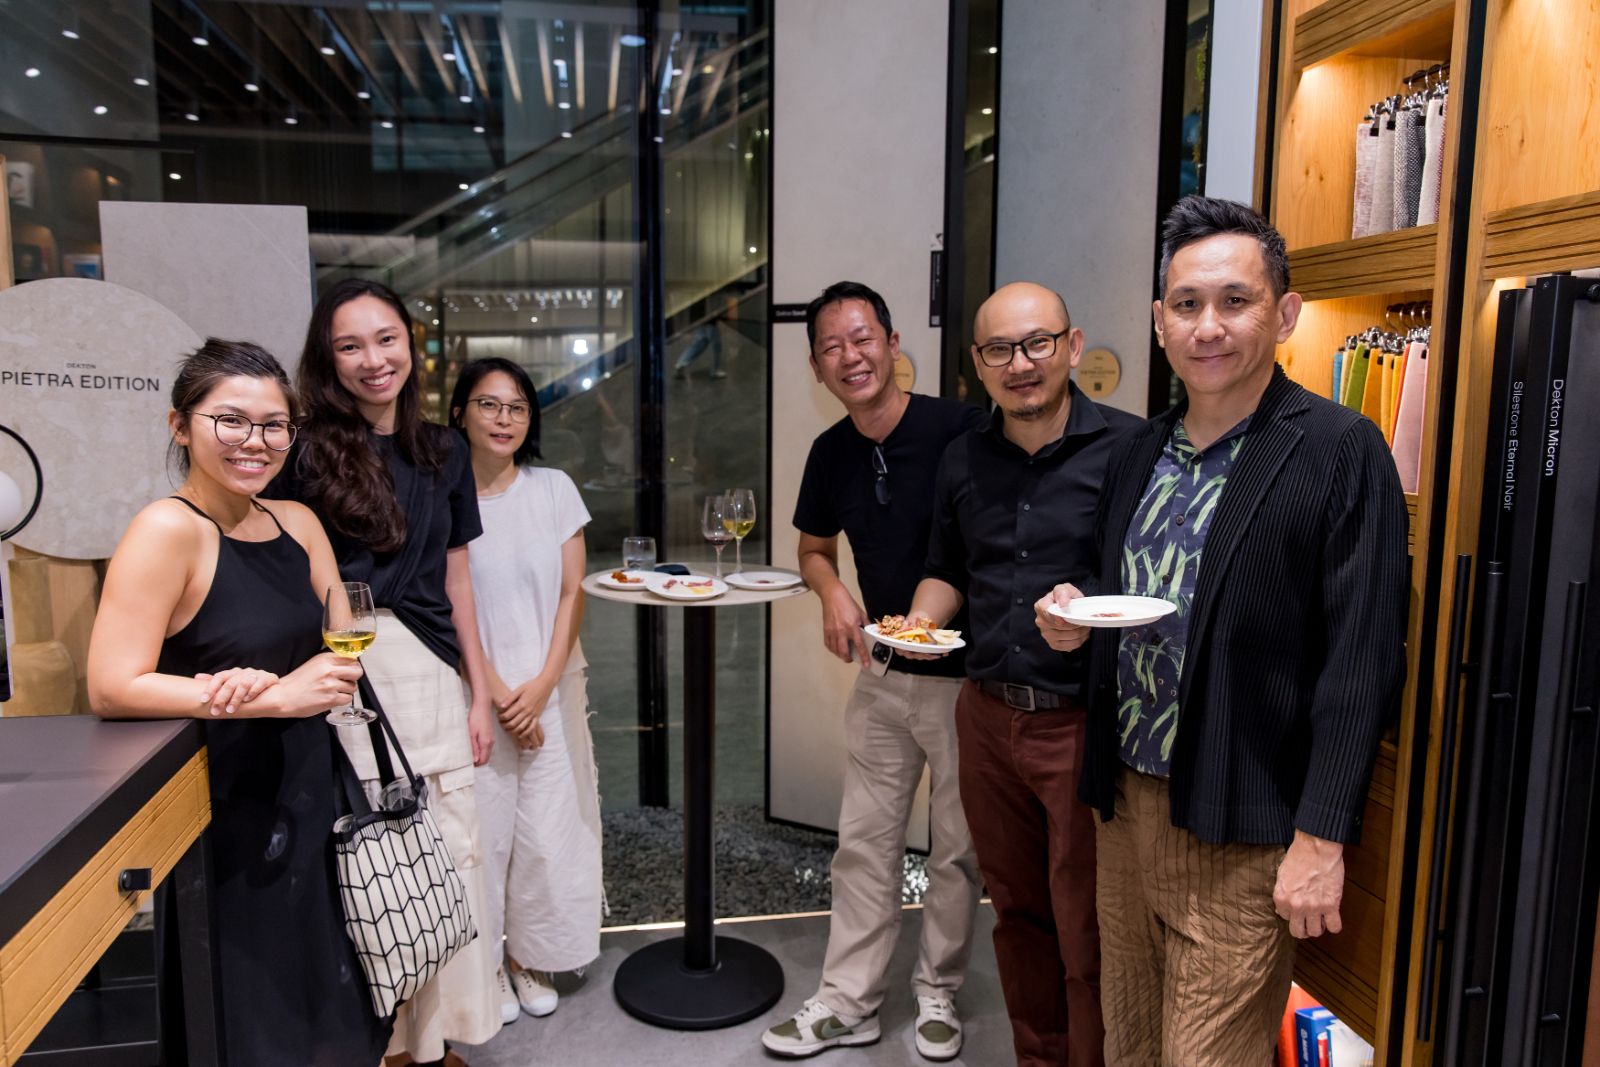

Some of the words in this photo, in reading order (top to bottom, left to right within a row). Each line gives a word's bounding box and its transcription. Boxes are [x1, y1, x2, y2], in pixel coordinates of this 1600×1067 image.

[2, 371, 74, 388] PIETRA
[80, 374, 160, 392] EDITION
[66, 362, 97, 370] DEKTON
[1509, 381, 1524, 437] Silestone
[1549, 379, 1564, 427] Dekton
[1506, 439, 1519, 482] Eternal
[1545, 429, 1560, 477] Micron
[1503, 485, 1515, 511] Noir
